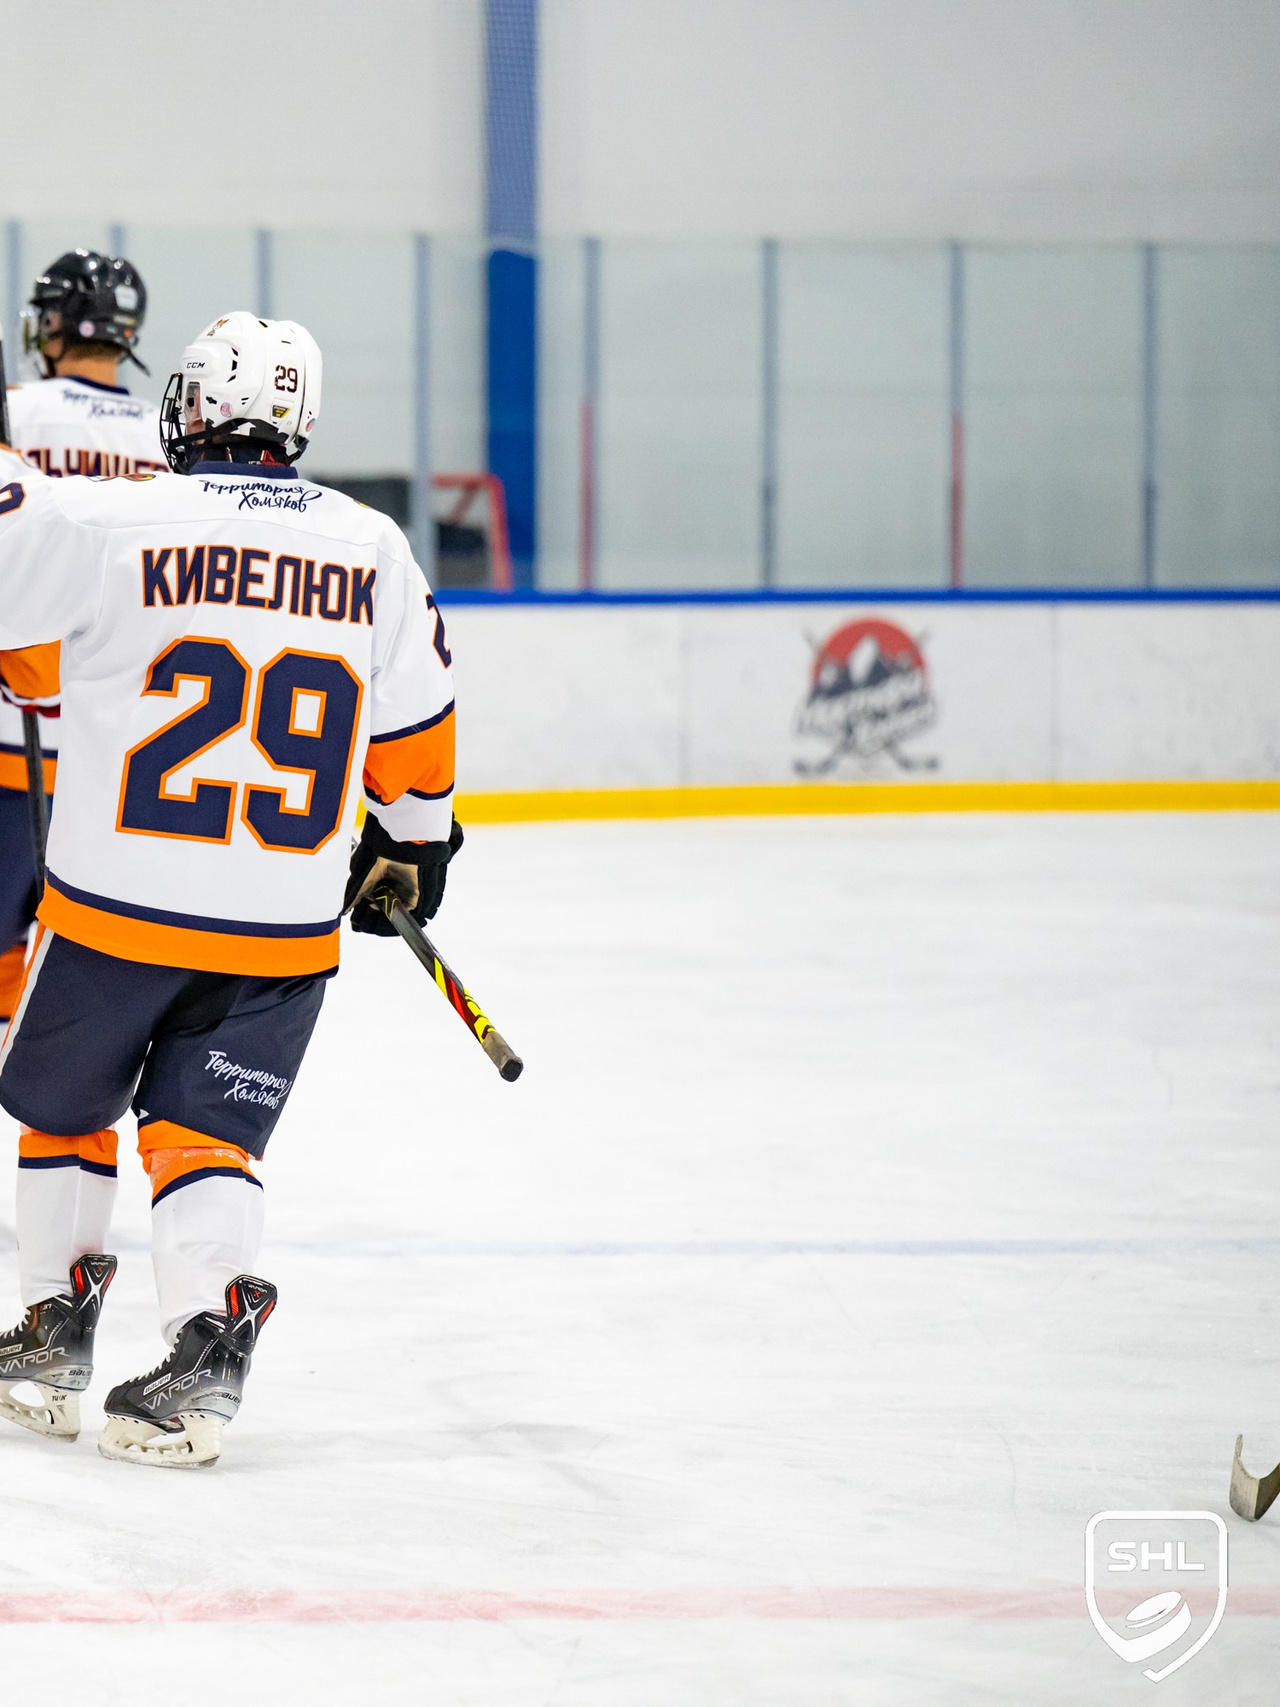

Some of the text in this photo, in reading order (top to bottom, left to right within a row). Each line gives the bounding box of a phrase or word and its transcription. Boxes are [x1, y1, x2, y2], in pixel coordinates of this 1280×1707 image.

[186, 361, 206, 369] CCM
[274, 364, 298, 393] 29
[198, 479, 305, 497] Территория
[238, 489, 323, 512] Хомяков
[141, 544, 377, 627] КИВЕЛЮК
[115, 634, 365, 856] 29
[204, 1050, 288, 1090] Территория
[223, 1079, 293, 1109] Хомяков
[139, 1368, 218, 1411] VAPOR
[144, 1374, 171, 1394] BAUER
